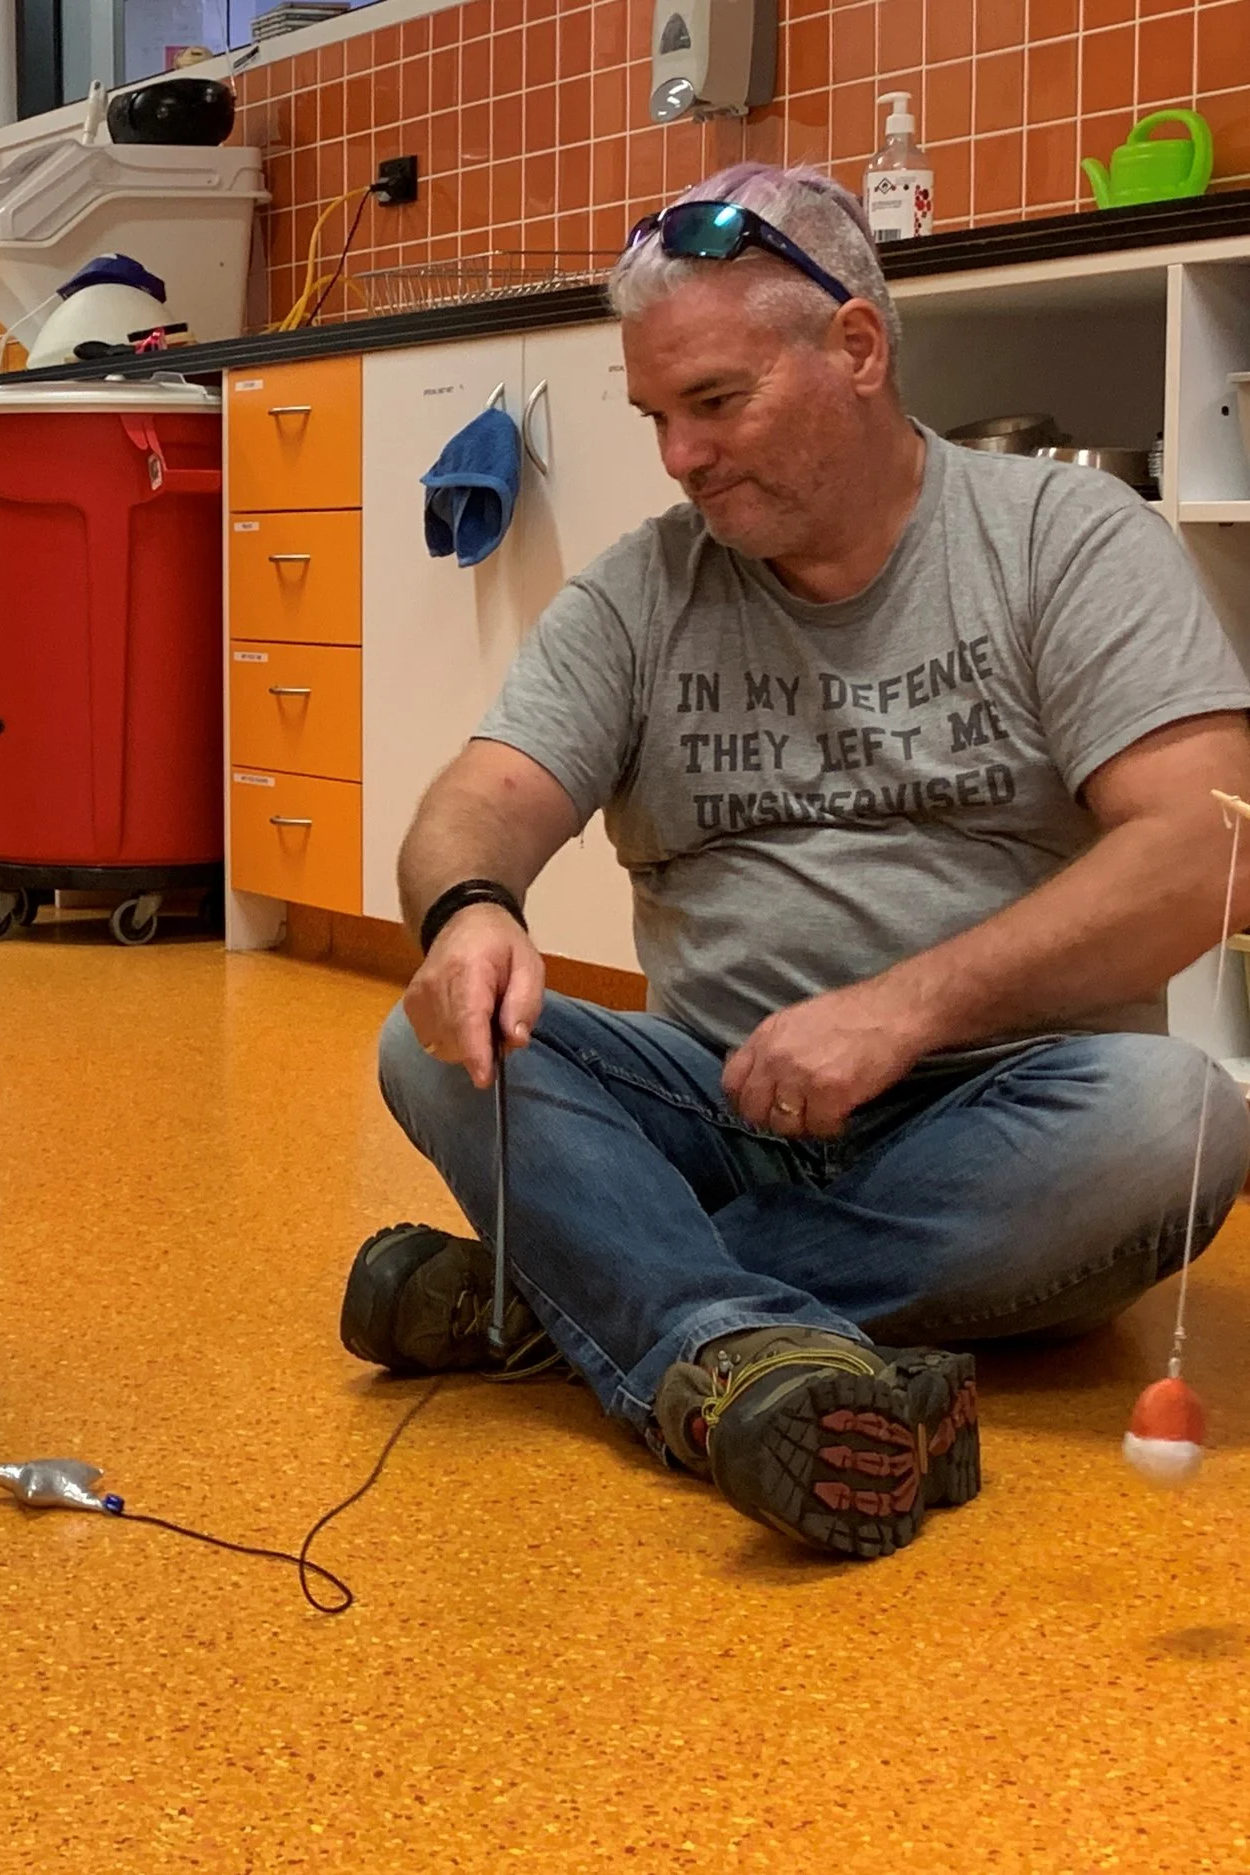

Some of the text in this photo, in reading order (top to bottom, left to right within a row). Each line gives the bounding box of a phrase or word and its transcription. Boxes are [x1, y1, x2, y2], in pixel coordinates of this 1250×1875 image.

[677, 671, 720, 713] IN
[744, 671, 800, 716] MY
[680, 729, 791, 774] THEY
[816, 726, 922, 774] LEFT
